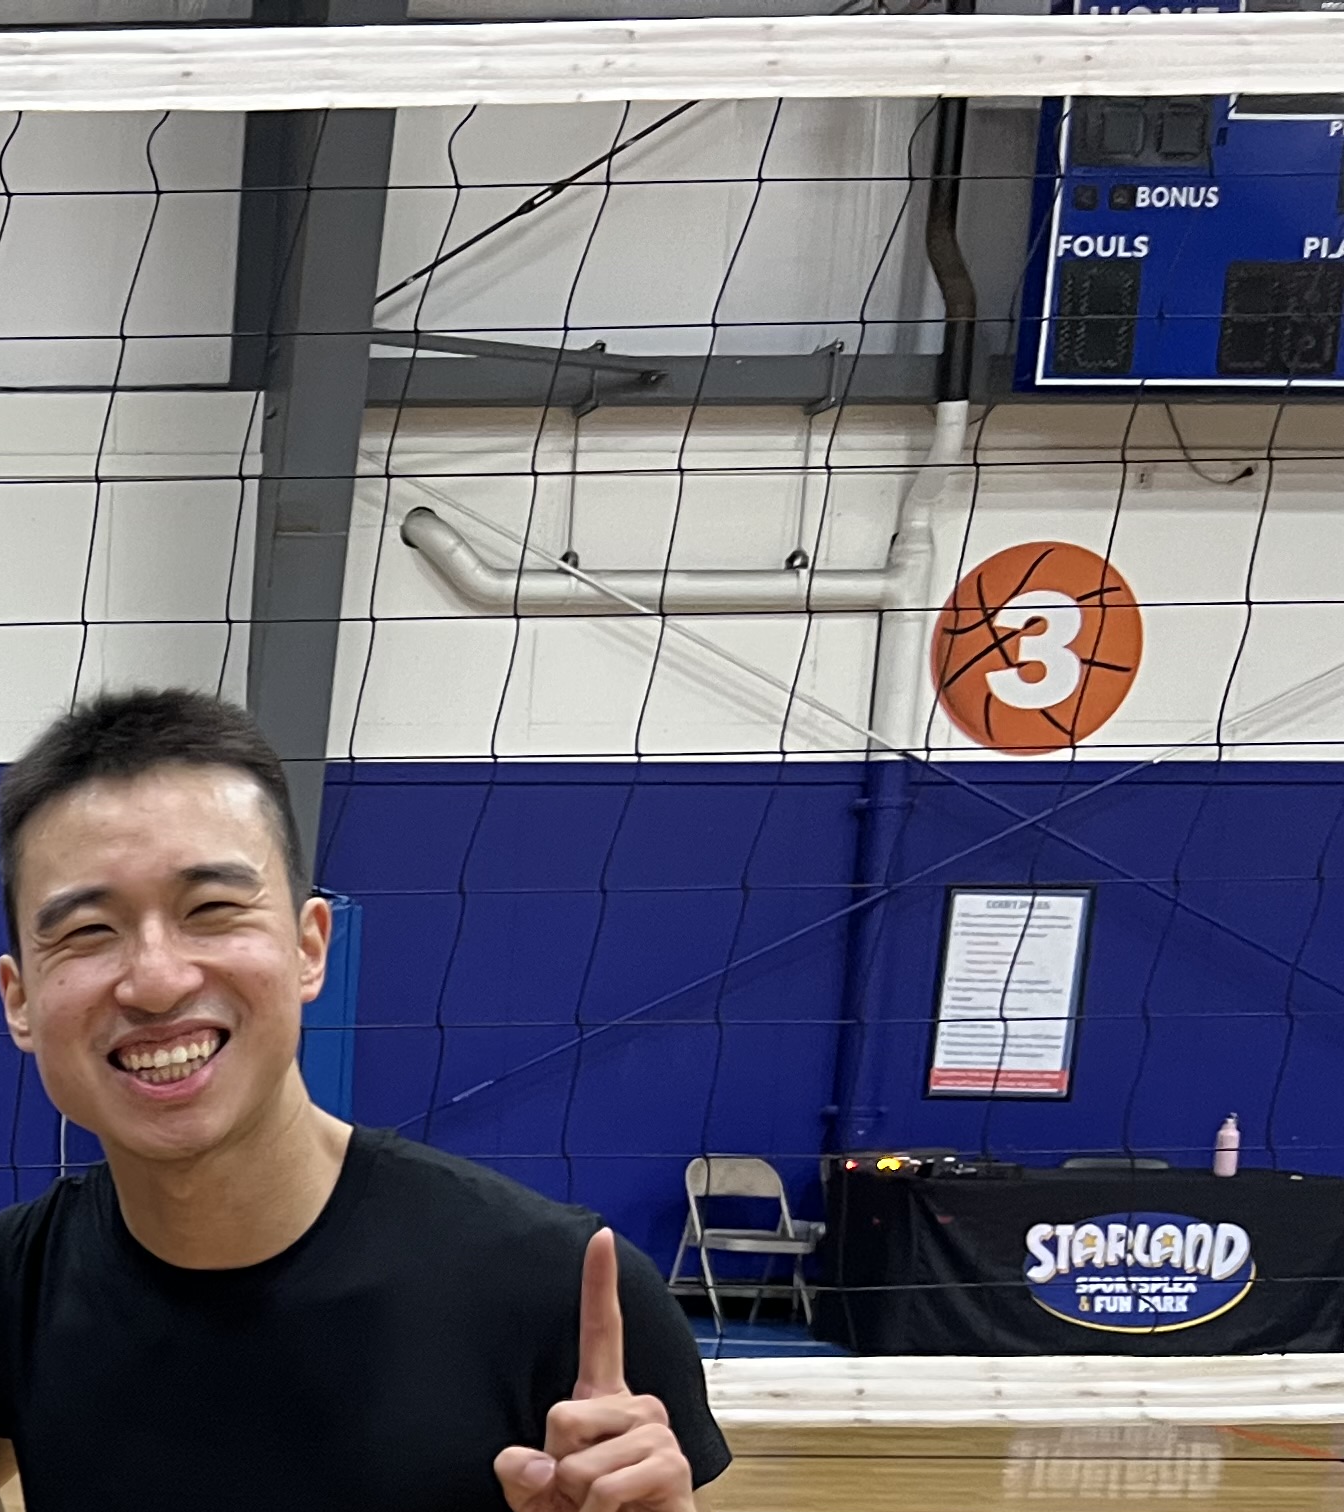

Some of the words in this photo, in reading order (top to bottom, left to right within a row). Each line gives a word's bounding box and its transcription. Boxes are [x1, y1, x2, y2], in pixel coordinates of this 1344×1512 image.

[1135, 186, 1219, 208] BONUS
[1056, 235, 1150, 258] FOULS
[985, 590, 1083, 710] 3
[1026, 1223, 1251, 1283] STARLAND
[1094, 1295, 1132, 1313] FUN
[1138, 1295, 1189, 1313] PARK
